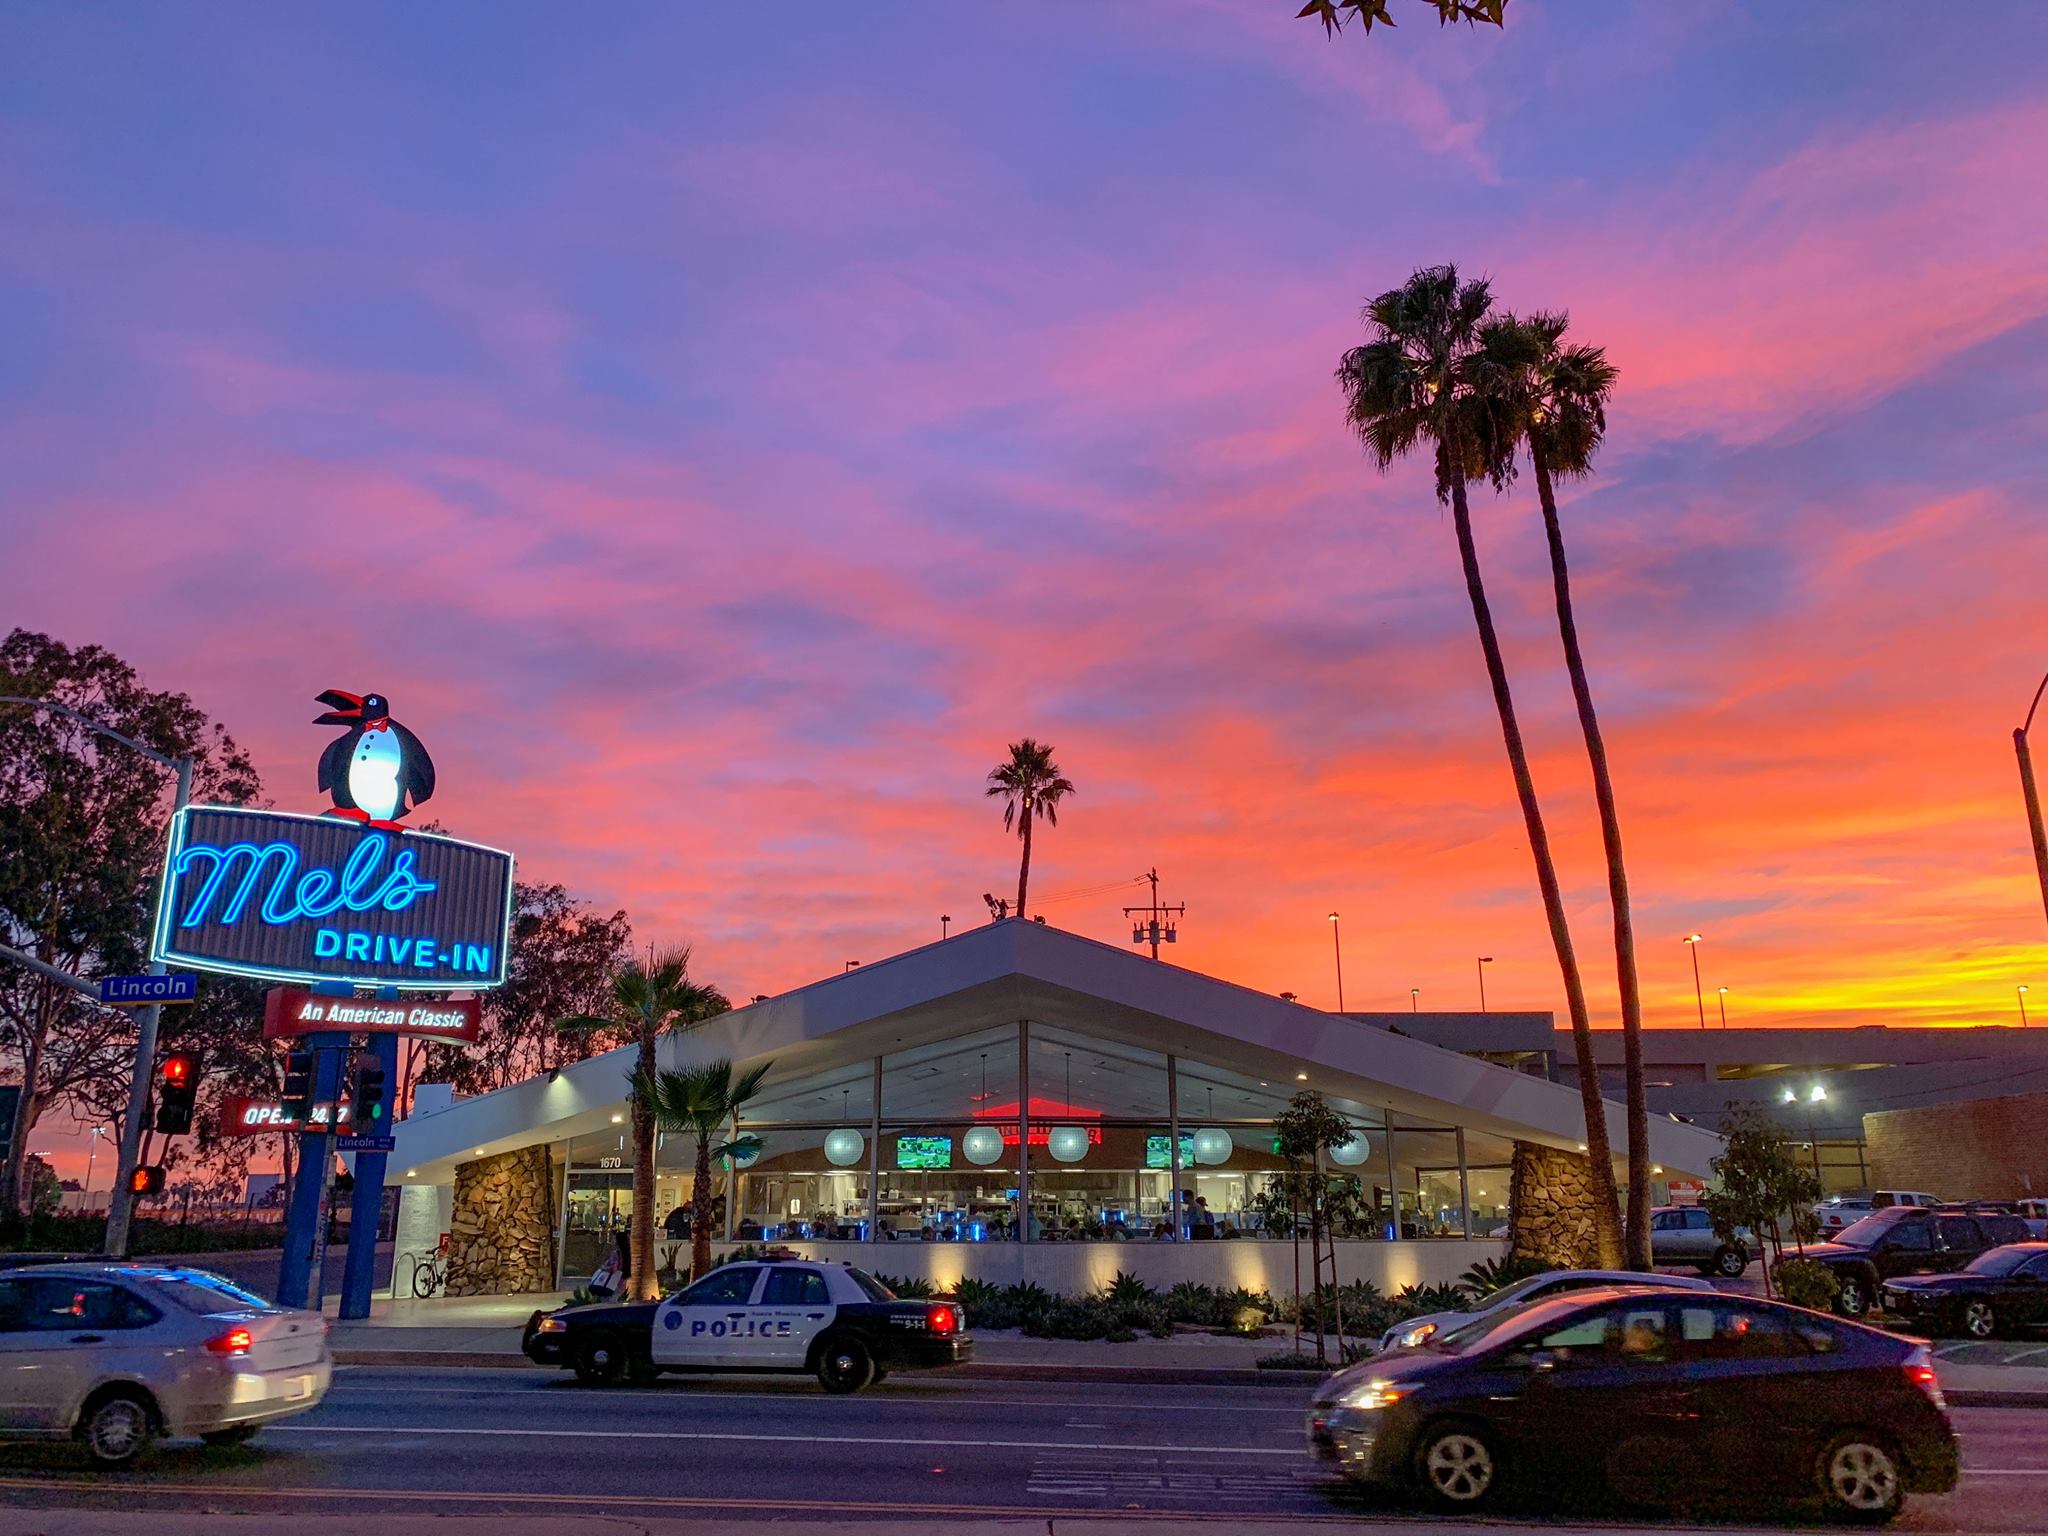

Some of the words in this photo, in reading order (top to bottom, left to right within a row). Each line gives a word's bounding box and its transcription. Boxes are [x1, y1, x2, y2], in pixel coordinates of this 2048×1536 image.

[175, 833, 437, 928] Mels
[315, 930, 490, 972] DRIVE-IN
[109, 977, 187, 996] Lincoln
[298, 1002, 323, 1021] An
[325, 1004, 405, 1025] American
[408, 1008, 465, 1028] Classic
[308, 1107, 349, 1124] 247
[339, 1137, 375, 1147] Lincoln
[600, 1157, 621, 1169] 1670
[690, 1320, 791, 1338] POLICE
